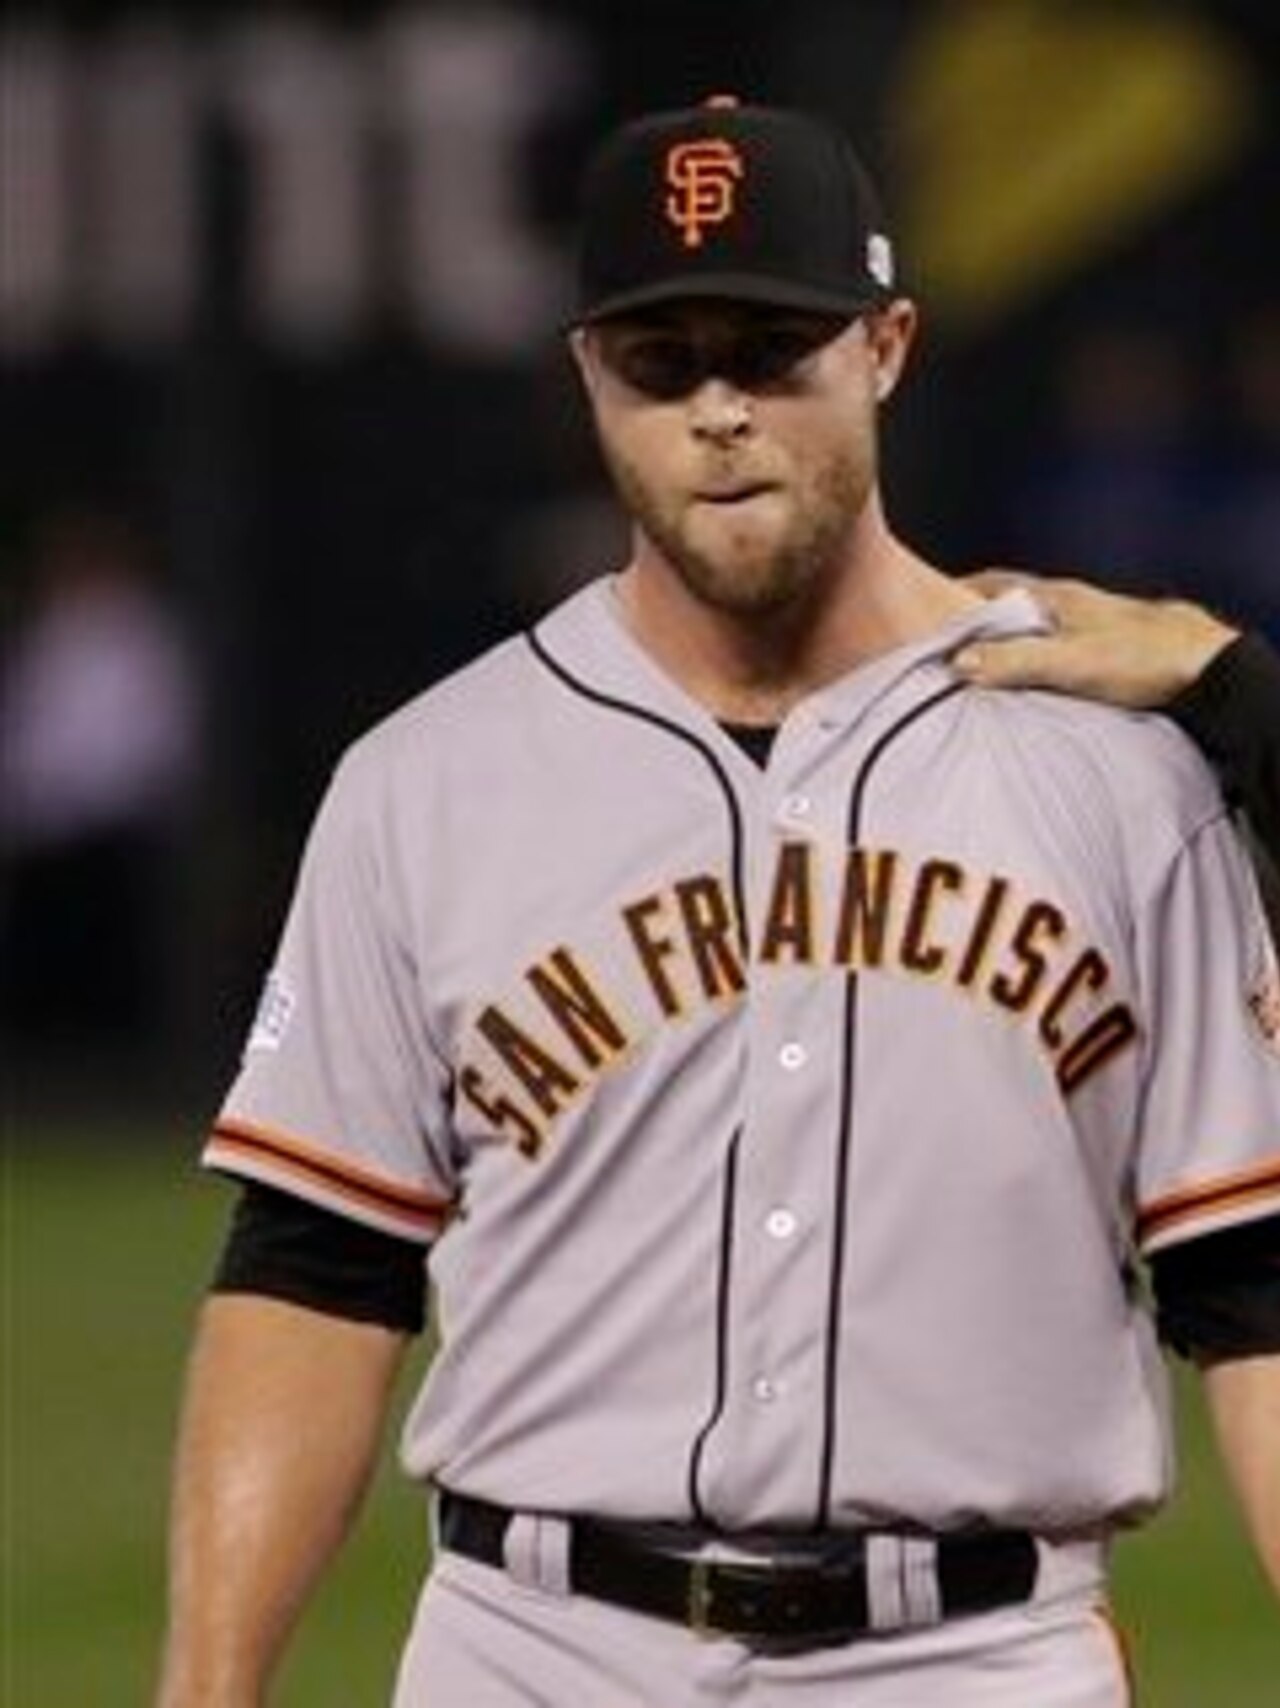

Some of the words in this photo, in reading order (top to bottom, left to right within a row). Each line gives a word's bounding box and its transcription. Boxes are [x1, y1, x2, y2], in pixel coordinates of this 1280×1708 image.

[667, 138, 743, 247] SF
[457, 943, 630, 1164] SAN
[620, 840, 1139, 1100] FRANCISCO
